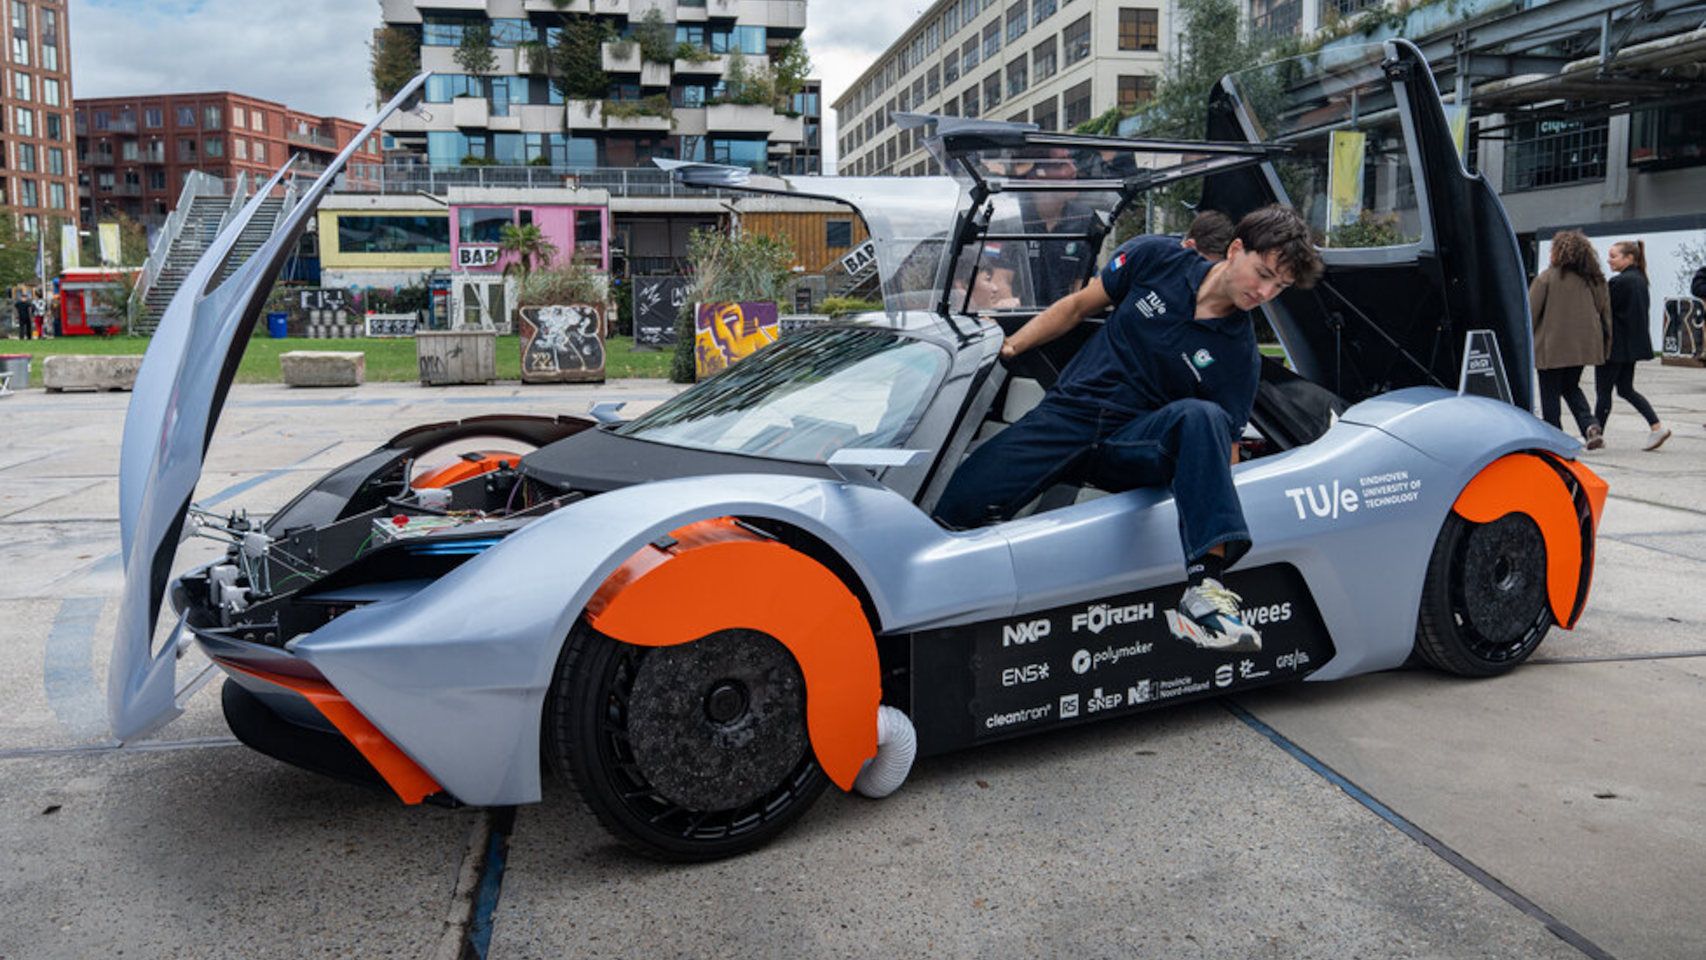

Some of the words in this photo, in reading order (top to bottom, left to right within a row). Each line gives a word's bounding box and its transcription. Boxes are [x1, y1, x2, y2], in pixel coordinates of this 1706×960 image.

[1360, 471, 1408, 486] EINDHOVEN
[1362, 482, 1408, 497] UNIVERSITY
[1410, 480, 1421, 490] OF
[1285, 479, 1359, 519] TU/e
[1365, 492, 1419, 508] TECHNOLOGY
[1003, 619, 1051, 647] NXP
[1093, 641, 1153, 670] polymaker
[1087, 693, 1123, 712] SNEP
